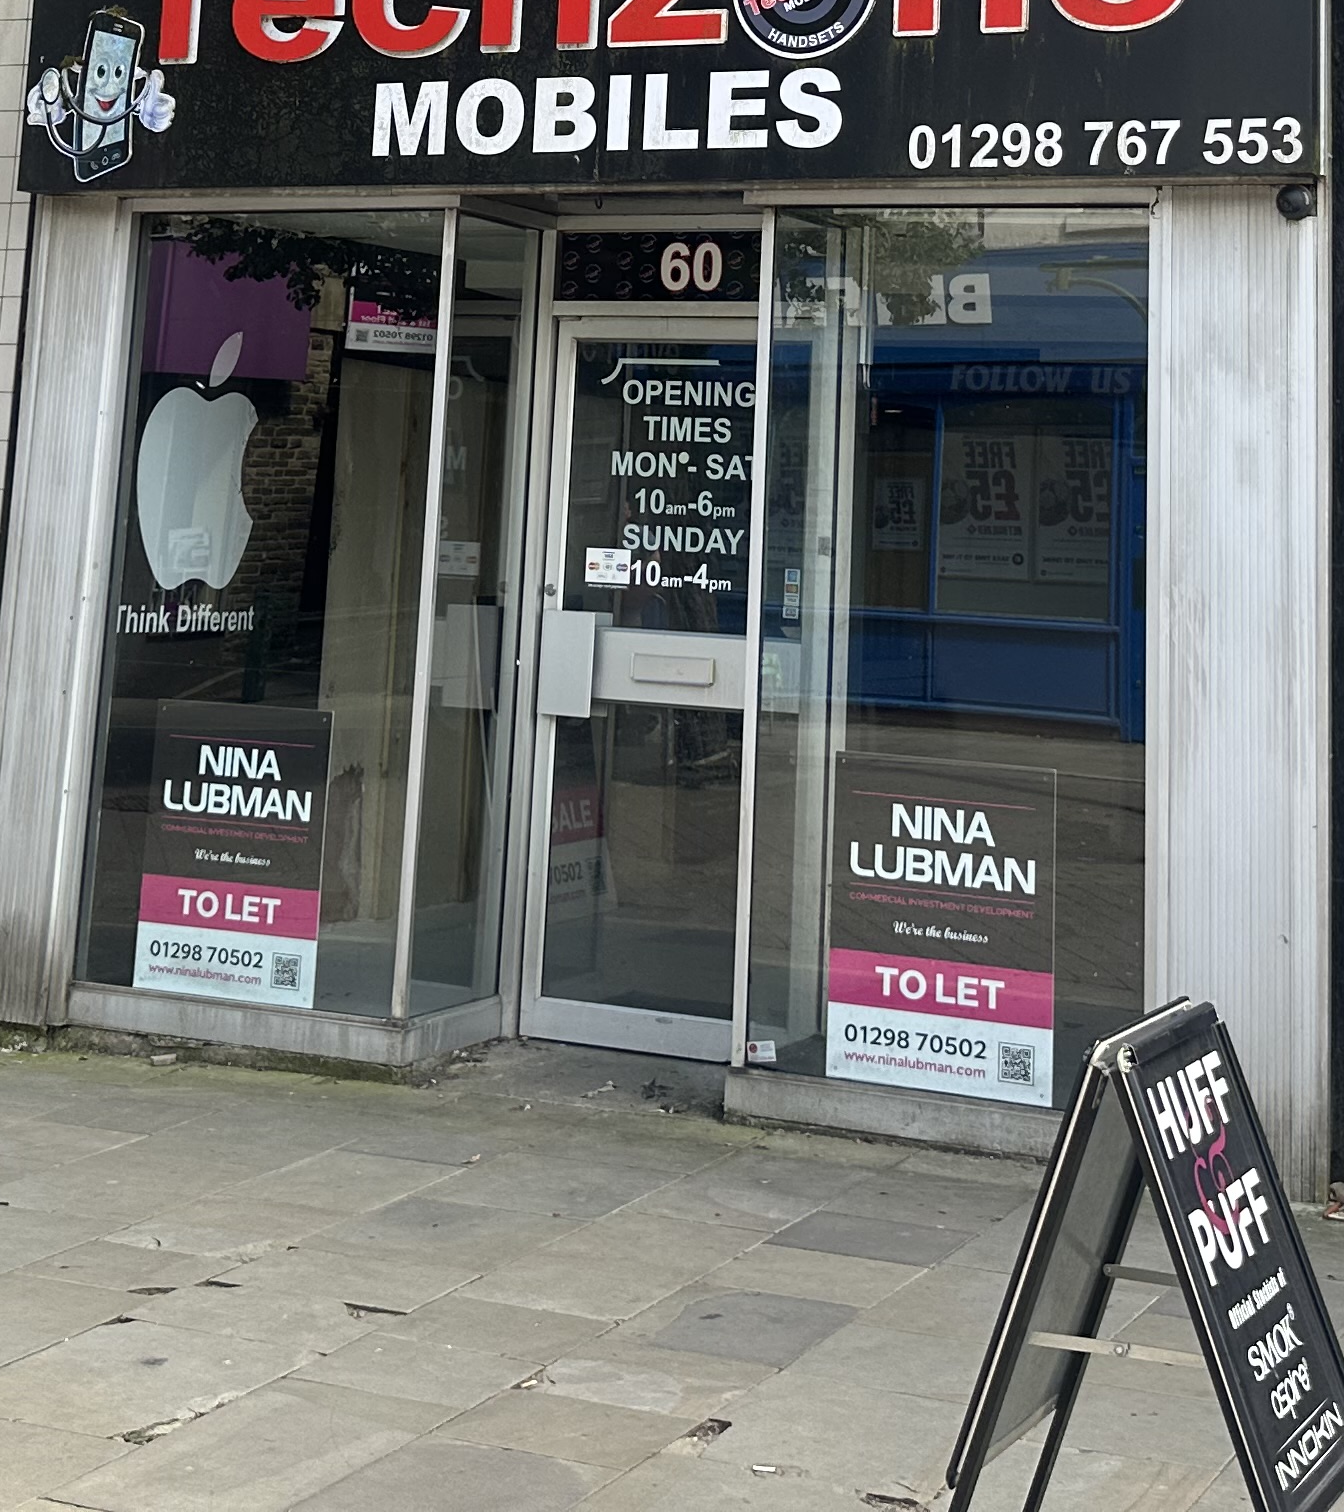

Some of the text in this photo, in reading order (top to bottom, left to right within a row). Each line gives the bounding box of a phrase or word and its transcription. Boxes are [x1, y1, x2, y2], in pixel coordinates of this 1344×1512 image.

[767, 21, 845, 48] HANDSETS
[371, 67, 843, 157] MOBILES
[907, 116, 1304, 170] 01298 767 553
[660, 241, 723, 293] 60
[623, 380, 755, 408] OPENING
[951, 365, 1134, 394] FOLLOW US
[643, 416, 732, 444] TIMES
[622, 524, 745, 556] SUNDAY
[116, 603, 254, 634] Think Different
[198, 745, 281, 781] NINA
[162, 779, 312, 822] LUBMAN
[891, 803, 996, 847] NINA
[194, 848, 271, 867] We're the business
[849, 841, 1036, 895] LUBMAN
[177, 888, 281, 924] TO LET
[849, 891, 1036, 921] COMMERCIAL INVESTMENT DEVELOPMENT
[892, 920, 989, 944] We're the business
[149, 939, 264, 969] 01298 70502
[149, 963, 262, 986] www.ninalubman.com
[875, 965, 1005, 1010] TO LET
[843, 1022, 987, 1060] 01298 70502
[843, 1049, 987, 1079] www.ninalubman.com
[1147, 1050, 1230, 1160] HUFF
[1188, 1167, 1271, 1287] PUFF
[1274, 1402, 1344, 1491] INNOKIN
